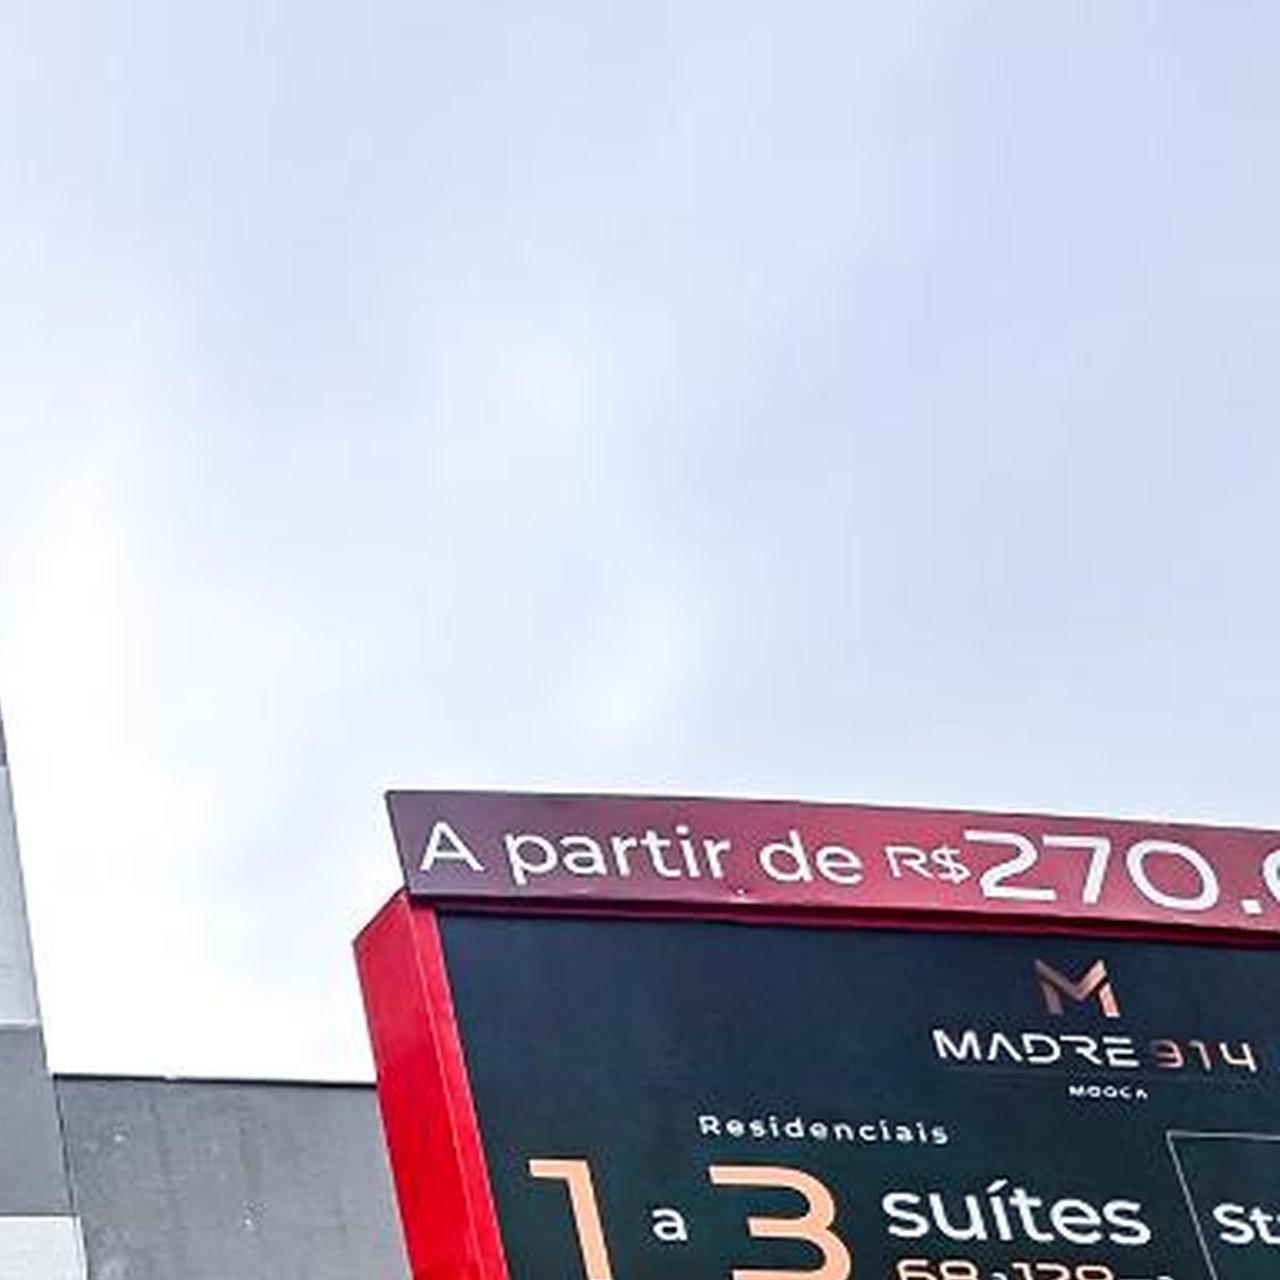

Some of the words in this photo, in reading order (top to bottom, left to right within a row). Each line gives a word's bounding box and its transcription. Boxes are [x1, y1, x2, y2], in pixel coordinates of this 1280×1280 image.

[419, 822, 484, 872] A
[504, 826, 731, 885] partir
[759, 830, 864, 884] de
[886, 829, 1280, 915] R$270.
[933, 1029, 1139, 1068] MADRE
[1068, 1085, 1148, 1100] MOOCA
[698, 1115, 949, 1144] Residenciais
[652, 1207, 688, 1242] a
[882, 1179, 1152, 1245] suítes
[1212, 1202, 1280, 1244] St
